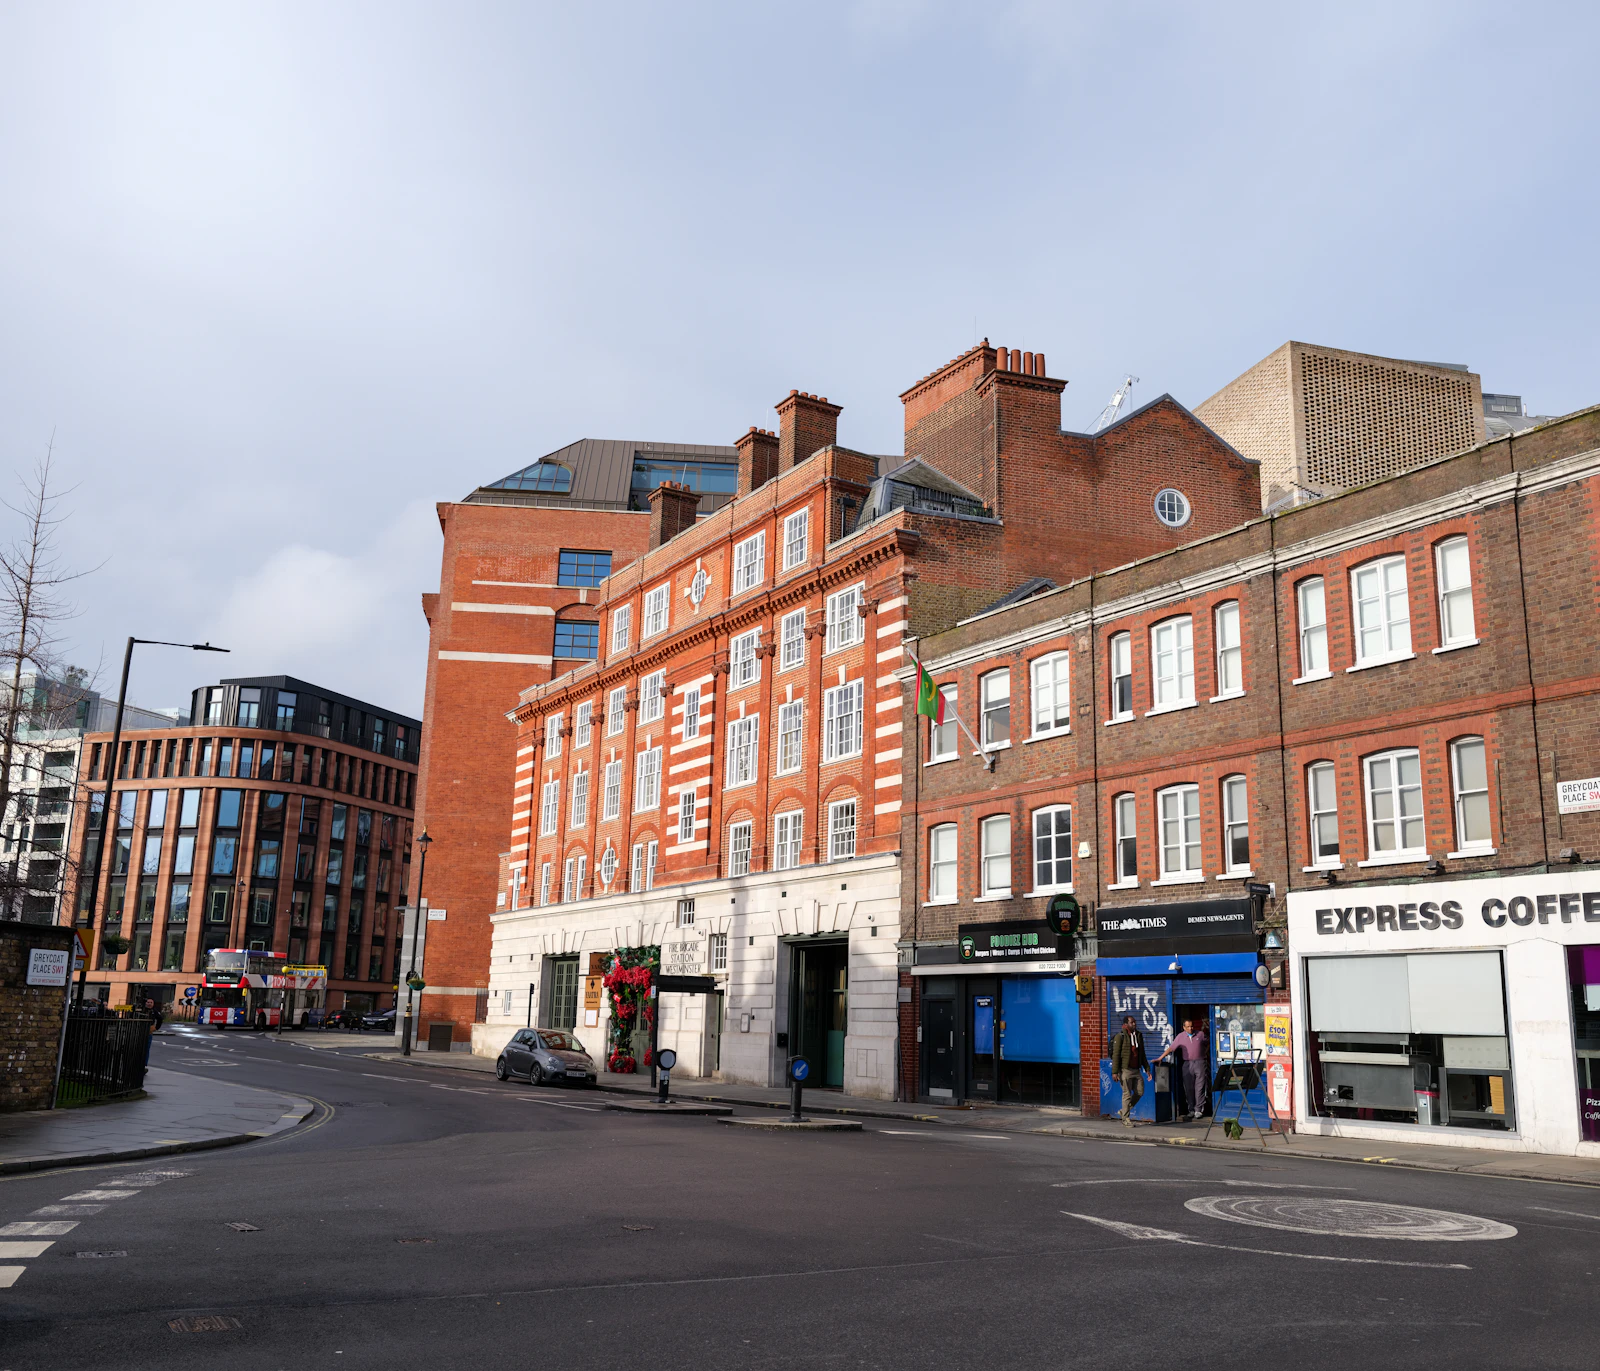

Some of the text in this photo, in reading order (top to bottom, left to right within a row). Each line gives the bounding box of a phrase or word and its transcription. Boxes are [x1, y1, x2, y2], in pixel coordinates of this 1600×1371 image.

[1563, 792, 1587, 803] PLACE
[1187, 913, 1244, 924] DEMES NEWSAGENTS
[1315, 892, 1600, 935] EXPRESS COFFE
[1101, 917, 1167, 931] THE TIMES
[1022, 932, 1039, 945] HUB
[669, 941, 699, 953] FIRE BRIGADE
[34, 953, 64, 964] GREYCOAT
[671, 953, 694, 963] STATION
[33, 964, 64, 974] PLACE SW1
[666, 964, 701, 974] WESTMINSTER
[1269, 1026, 1286, 1034] £100
